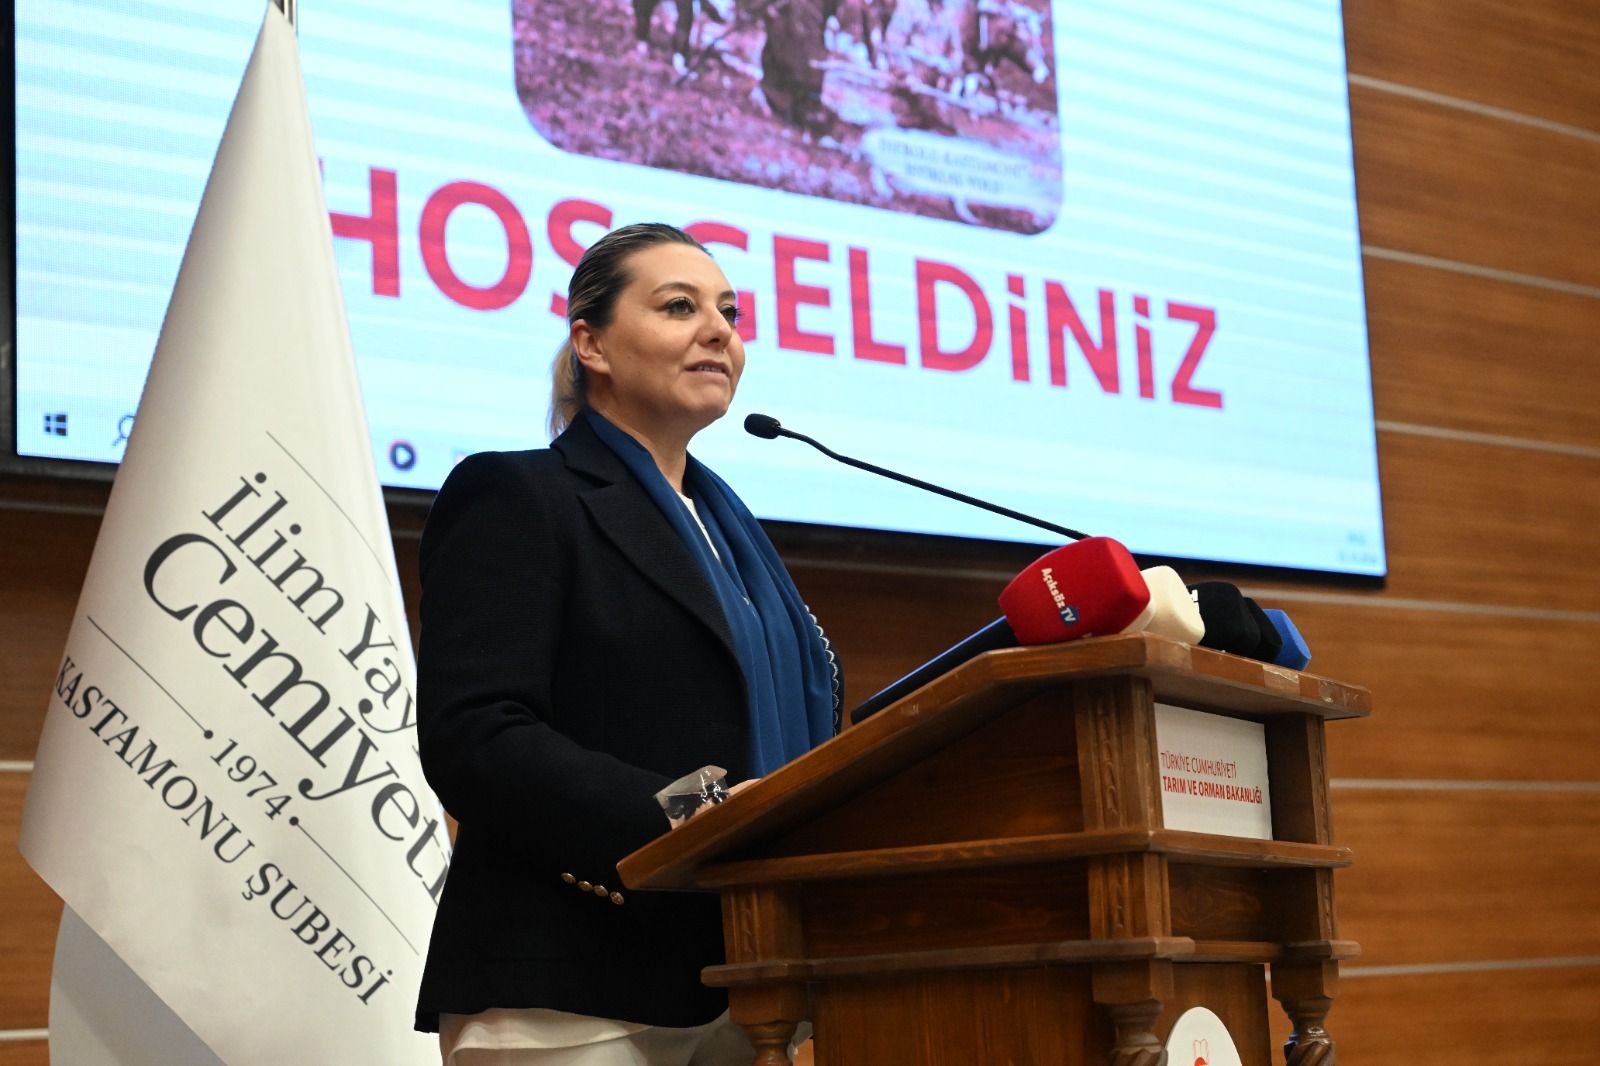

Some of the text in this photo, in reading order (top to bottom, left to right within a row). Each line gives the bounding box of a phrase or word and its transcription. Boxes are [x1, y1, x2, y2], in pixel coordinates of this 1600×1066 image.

[201, 471, 346, 635] İlim
[1060, 607, 1077, 622] TV
[210, 737, 296, 822] 1974
[1160, 750, 1237, 779] TÜRKİYE CUMHURİYETİ
[1162, 775, 1263, 805] TARIM VE ORMAN BAKANLIĞI
[55, 656, 394, 1006] KASTAMONU ŞUBESİ
